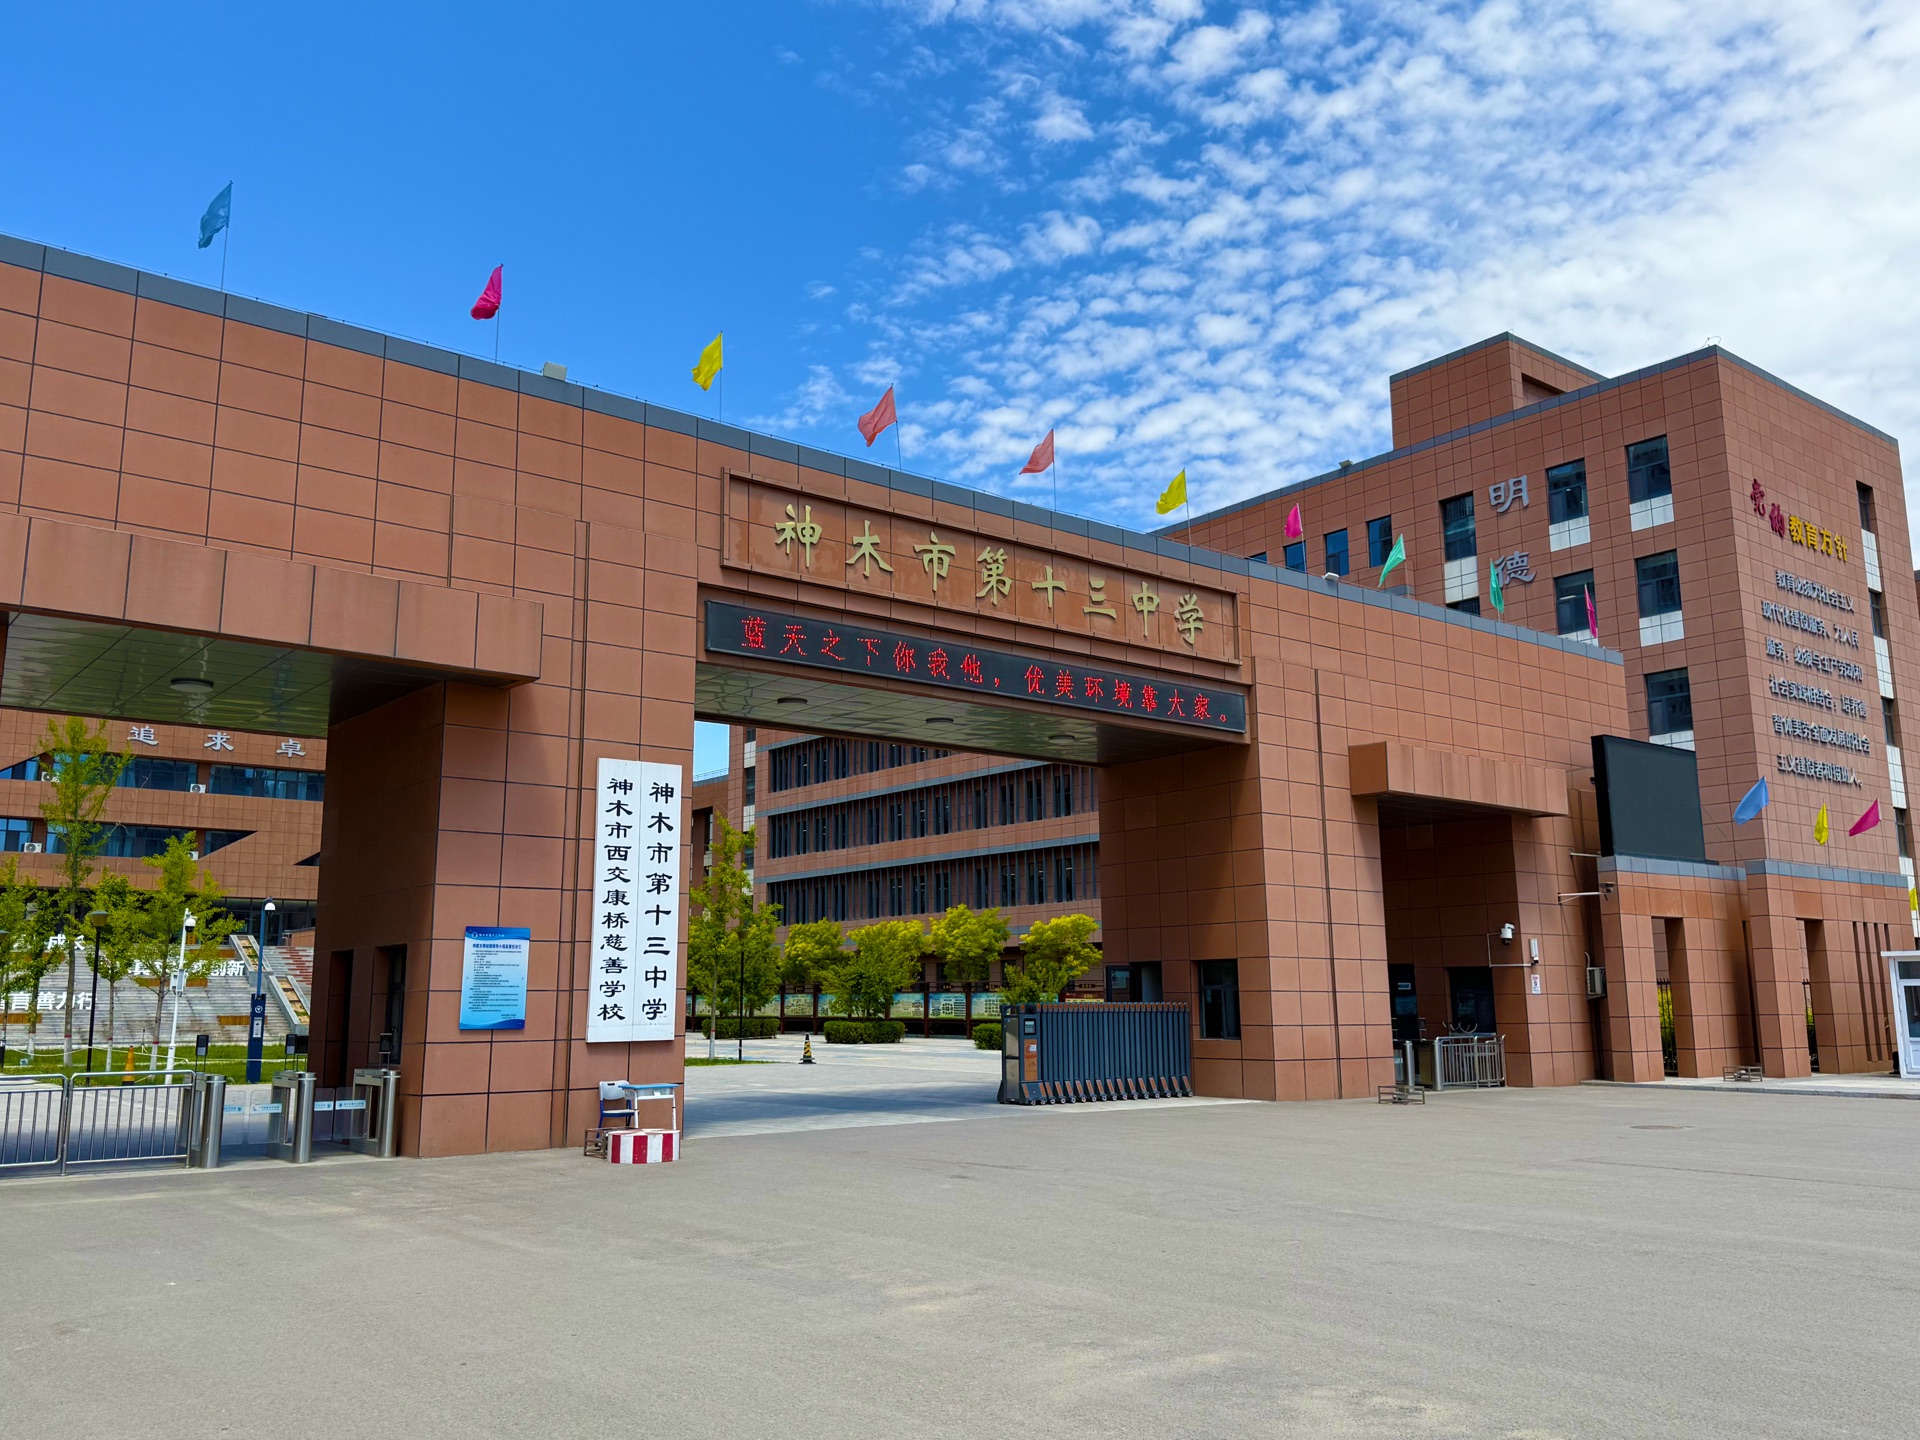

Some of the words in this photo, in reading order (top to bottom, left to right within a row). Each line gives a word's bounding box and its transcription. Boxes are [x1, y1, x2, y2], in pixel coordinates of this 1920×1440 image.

[775, 504, 1204, 646] 神木市第十三中学
[1488, 475, 1538, 589] 明德
[1750, 478, 1848, 563] 党的教育方针
[1775, 569, 1855, 613] 教育必须为社会主义
[597, 777, 633, 1021] 神木市西交康桥慈善学校
[641, 781, 675, 1021] 神木市第十三中学
